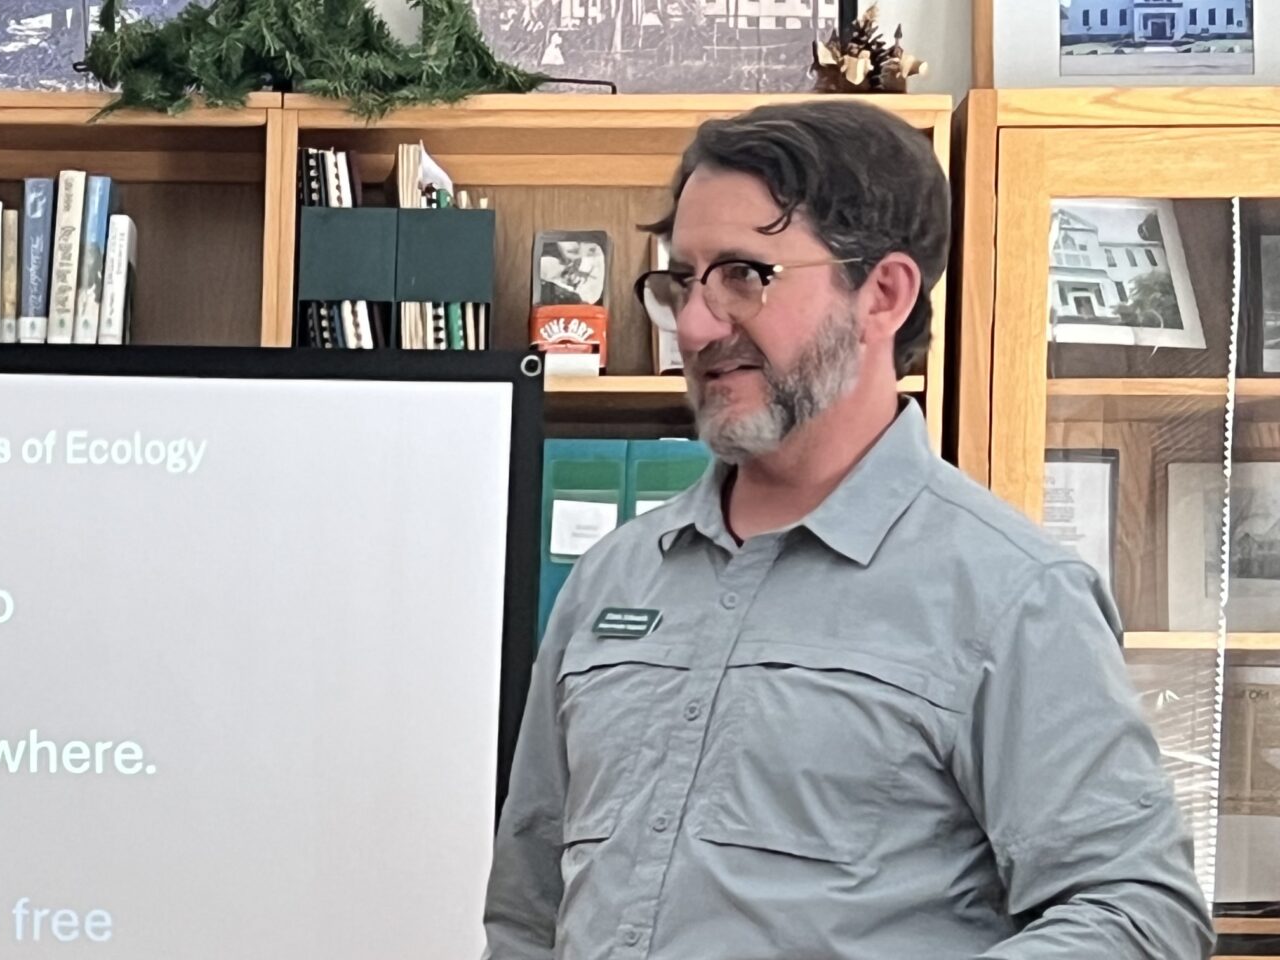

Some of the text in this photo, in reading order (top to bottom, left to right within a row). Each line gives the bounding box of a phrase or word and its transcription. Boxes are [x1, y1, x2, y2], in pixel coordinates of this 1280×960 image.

[21, 429, 56, 465] of
[65, 430, 207, 475] Ecology
[12, 896, 114, 942] free
